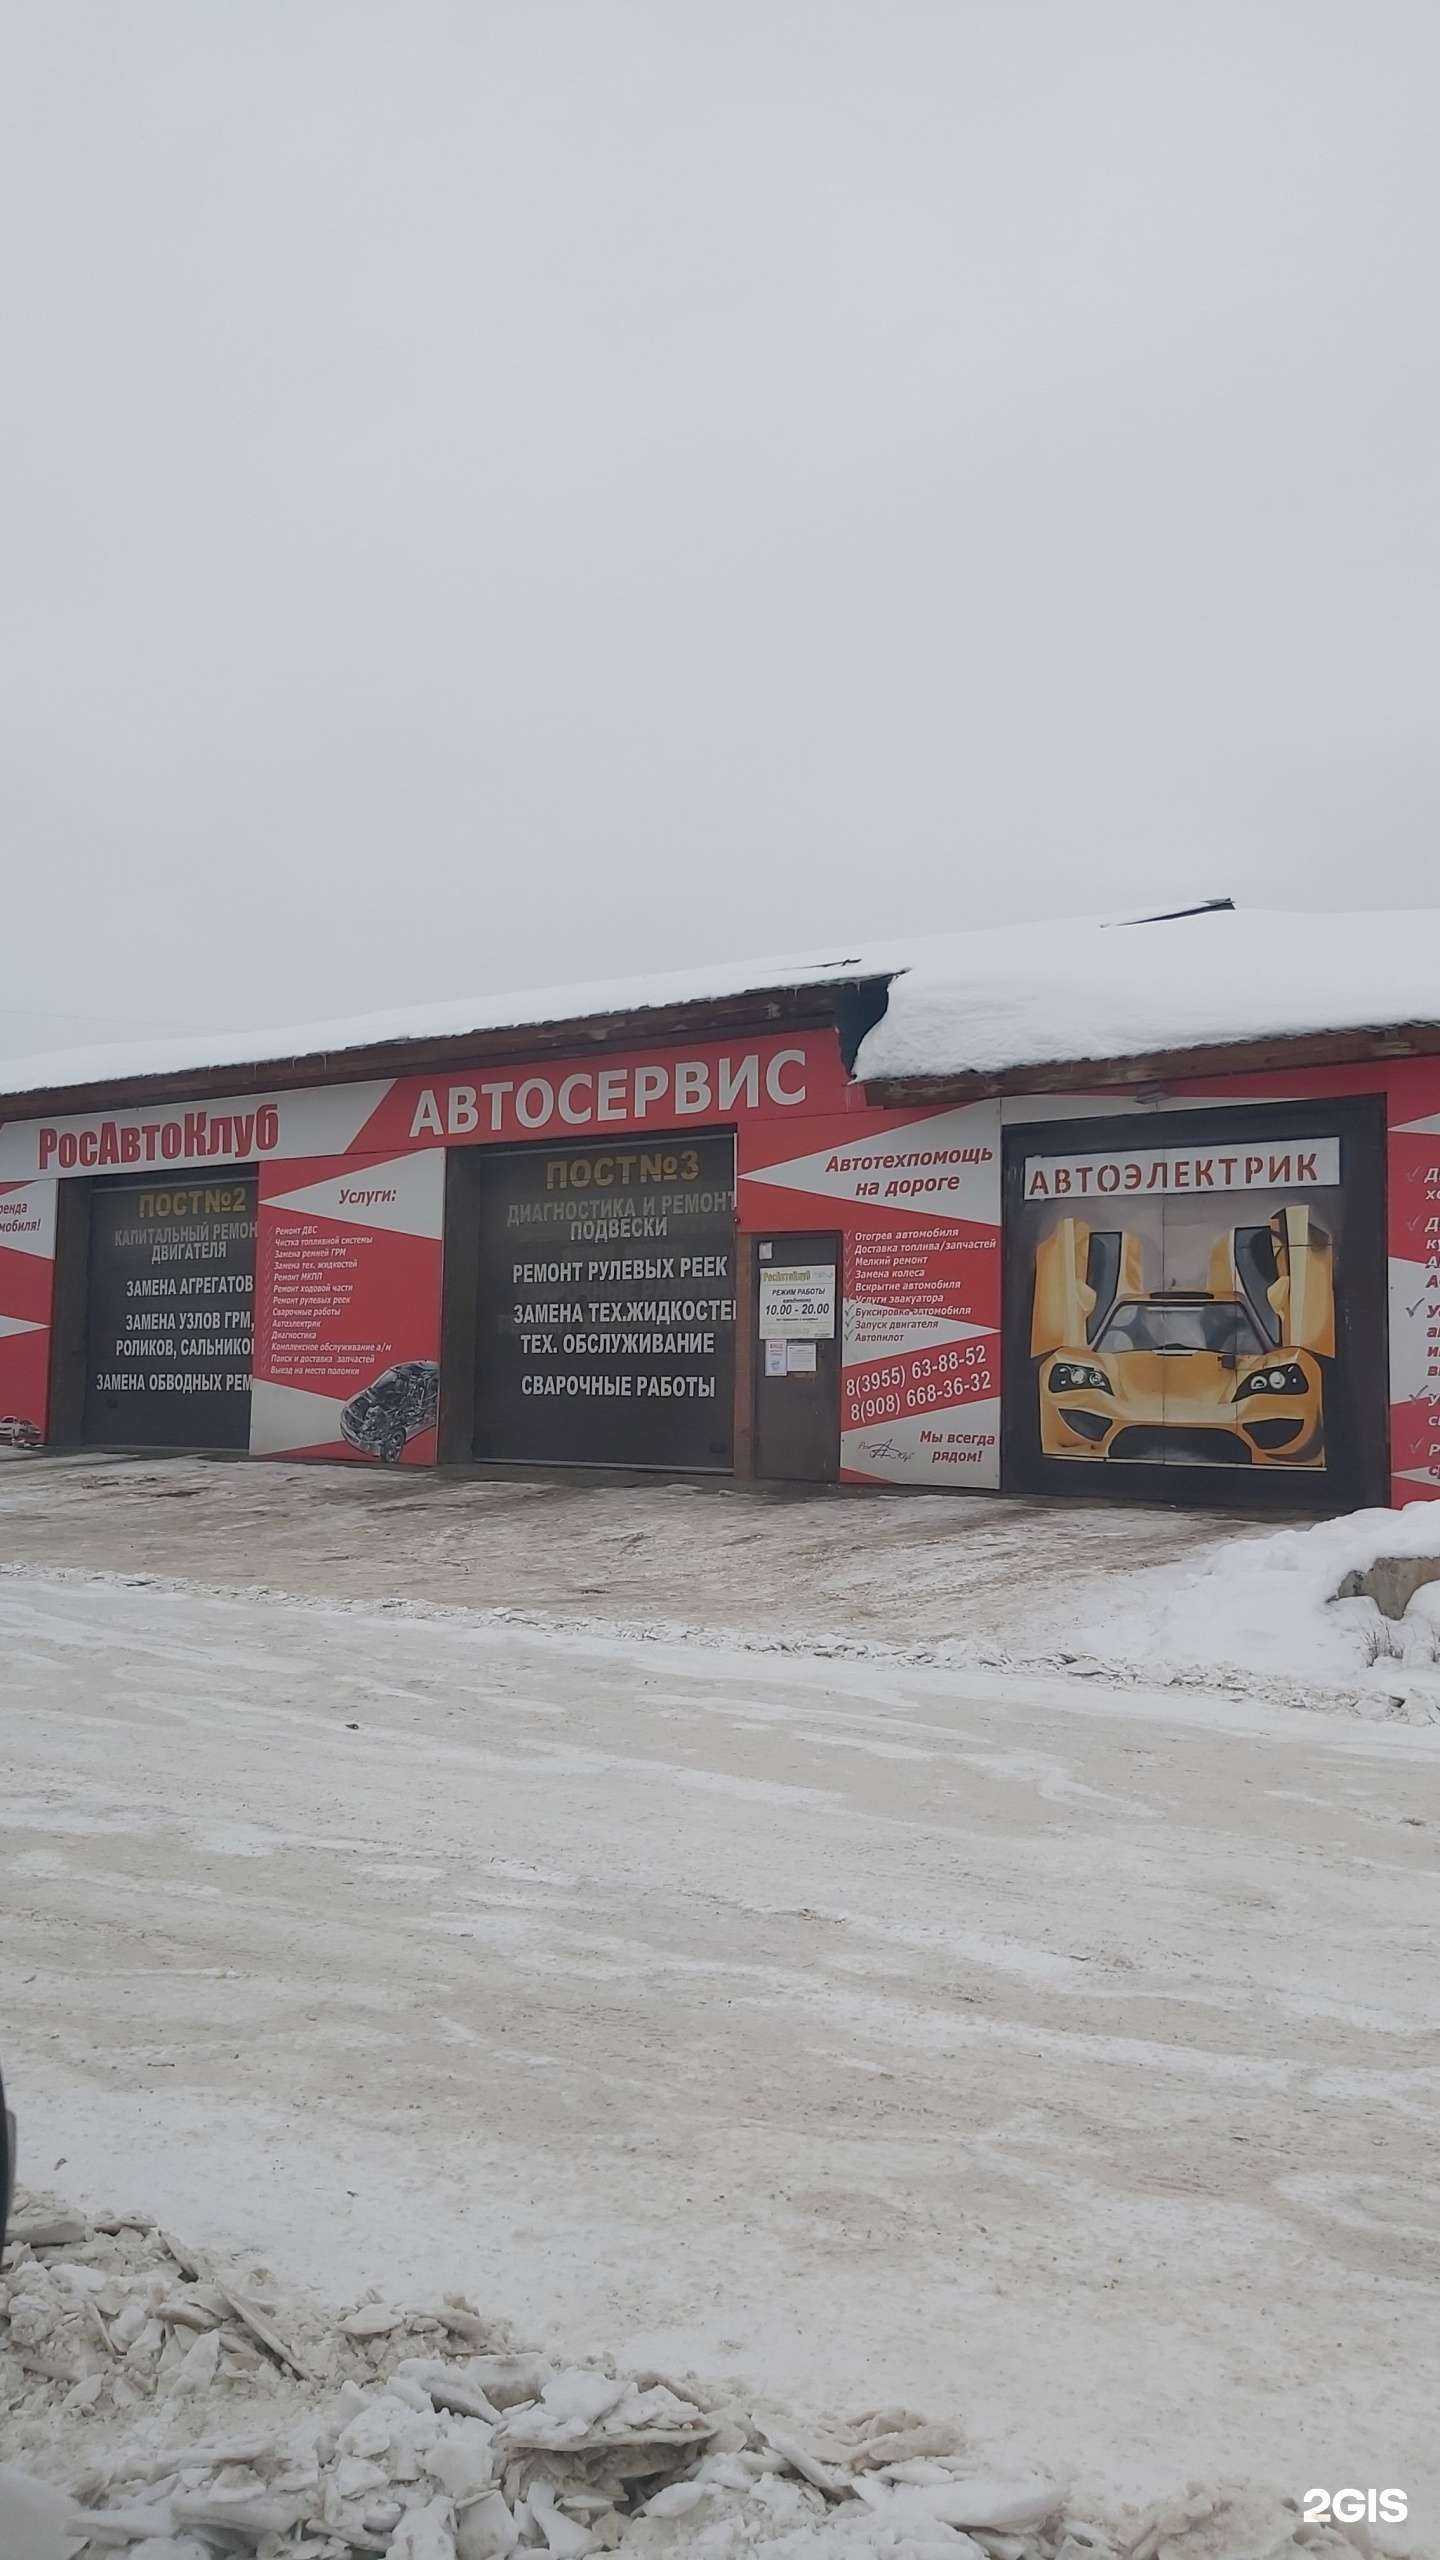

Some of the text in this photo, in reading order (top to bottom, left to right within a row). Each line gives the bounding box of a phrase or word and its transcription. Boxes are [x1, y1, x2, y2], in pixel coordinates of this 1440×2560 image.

[409, 1050, 806, 1137] АВТОСЕРВИС
[38, 1104, 279, 1170] РосАвтоКлуб
[825, 1146, 993, 1173] Автотехпомощь
[1028, 1153, 1318, 1195] АВТОЭЛЕКТРИК
[855, 1176, 960, 1198] на дороге
[338, 1187, 397, 1206] Услуги:
[507, 1198, 636, 1227] ДИАГНОСТИКА
[644, 1198, 656, 1216] И
[115, 1222, 258, 1246] КАПИТАЛЬНЫЙ РЕМОН
[275, 1225, 318, 1236] Ремонт ДВС
[570, 1216, 668, 1243] ПОДВЕСКИ
[855, 1228, 959, 1242] Отогрев автомобиля
[275, 1236, 373, 1247] Чистка топливной системы
[854, 1239, 996, 1255] Доставка топлива/запчастей
[151, 1241, 227, 1264] ДВИГАТЕЛЯ
[274, 1249, 301, 1259] Замена
[331, 1248, 346, 1256] ГРМ
[274, 1261, 300, 1270] Замена
[855, 1256, 928, 1268] Мелкий ремонт
[274, 1273, 299, 1281] Ремонт
[513, 1256, 728, 1284] РЕМОНТ РУЛЕВЫХ РЕЕК
[855, 1269, 925, 1279] Замена колеса
[126, 1275, 253, 1297] ЗАМЕНА АГРЕГАТОВ
[273, 1283, 353, 1294] Ремонт ходовой части
[772, 1287, 826, 1296] РЕЖИМ РАБОТЫ
[855, 1279, 961, 1293] Вскрытие автомобиля
[273, 1296, 299, 1304] Ремонт
[300, 1296, 331, 1306] рулевых
[855, 1294, 944, 1305] Услуги эвакуатора
[272, 1307, 341, 1318] Сварочные работы
[513, 1299, 736, 1326] ЗАМЕНА ТЕХ.ЖИДКОСТЕ
[766, 1304, 792, 1316] 10.00
[802, 1303, 829, 1315] 20.00
[855, 1305, 972, 1319] Буксировка автомобиля
[126, 1311, 255, 1332] ЗАМЕНА УЗЛОВ ГРМ,
[855, 1319, 939, 1331] Запуск двигателя
[271, 1331, 317, 1341] Диагностика
[520, 1332, 715, 1354] ТЕХ. ОБСЛУЖИВАНИЕ
[854, 1333, 904, 1342] Автопилот
[116, 1339, 177, 1360] РОЛИКОВ,
[271, 1342, 318, 1352] Комплексное
[320, 1342, 375, 1353] обслуживание
[300, 1355, 333, 1364] доставка
[845, 1344, 987, 1397] 8(3955) 63-88-52
[96, 1374, 253, 1394] ЗАМЕНА ОБВОДНЫХ РЕМ
[521, 1375, 716, 1398] СВАРОЧНЫЕ РАБОТЫ
[850, 1370, 991, 1424] 8(908) 668-36-32
[920, 1430, 996, 1446] Мы всегда
[932, 1450, 983, 1463] рядом!
